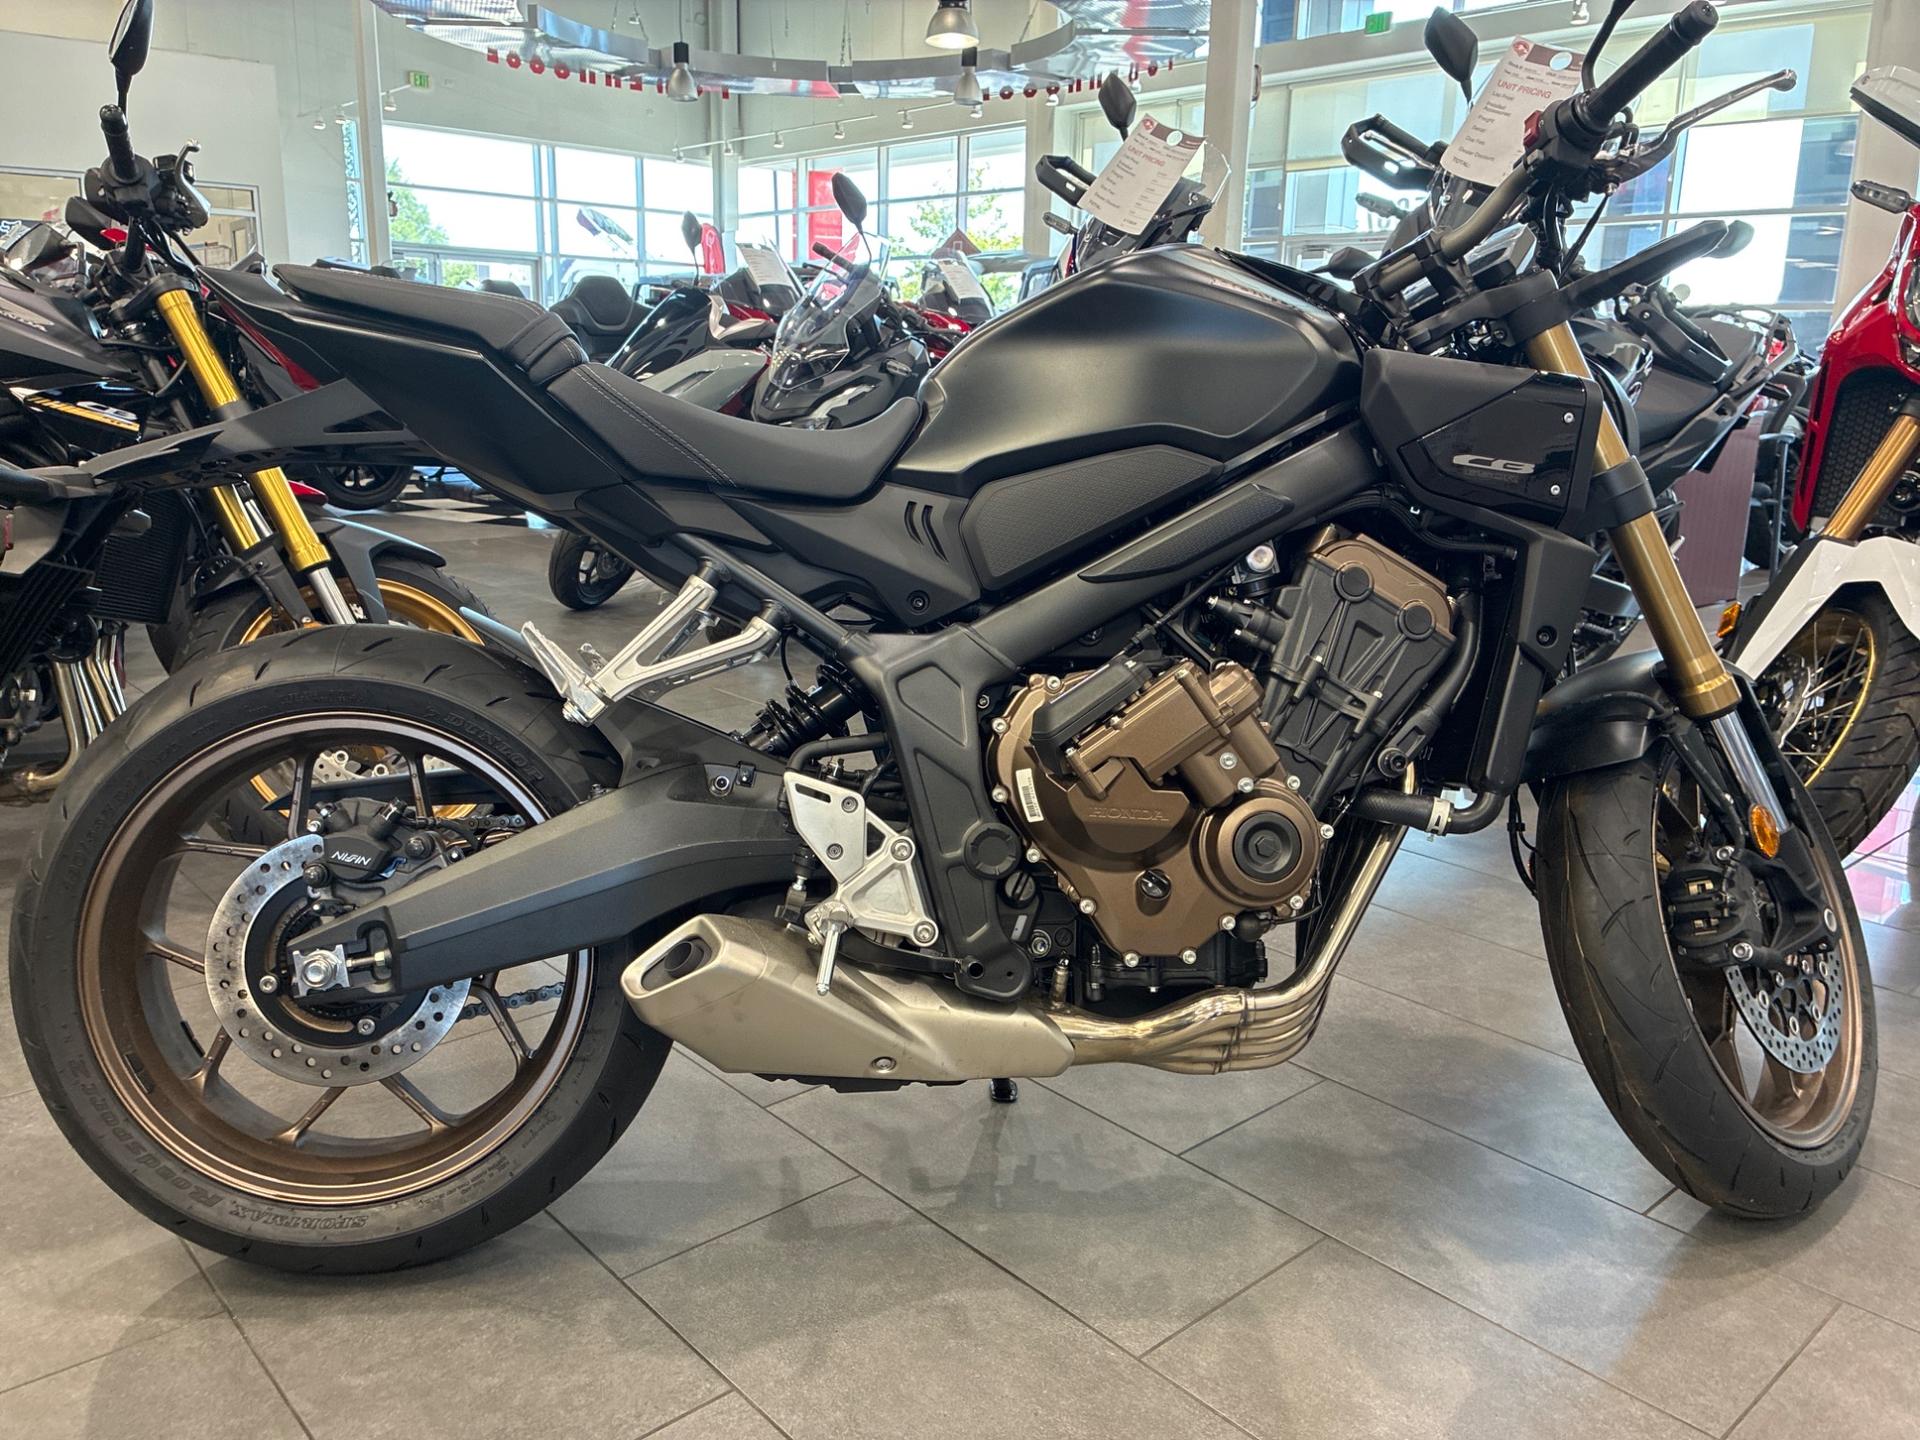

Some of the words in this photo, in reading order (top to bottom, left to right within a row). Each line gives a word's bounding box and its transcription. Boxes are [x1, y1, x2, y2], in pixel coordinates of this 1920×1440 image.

[1497, 80, 1517, 92] UNIT
[1518, 85, 1552, 99] PRICING
[1452, 453, 1536, 475] CB
[1087, 806, 1170, 822] HONDA
[231, 1203, 370, 1230] SPORTMAX
